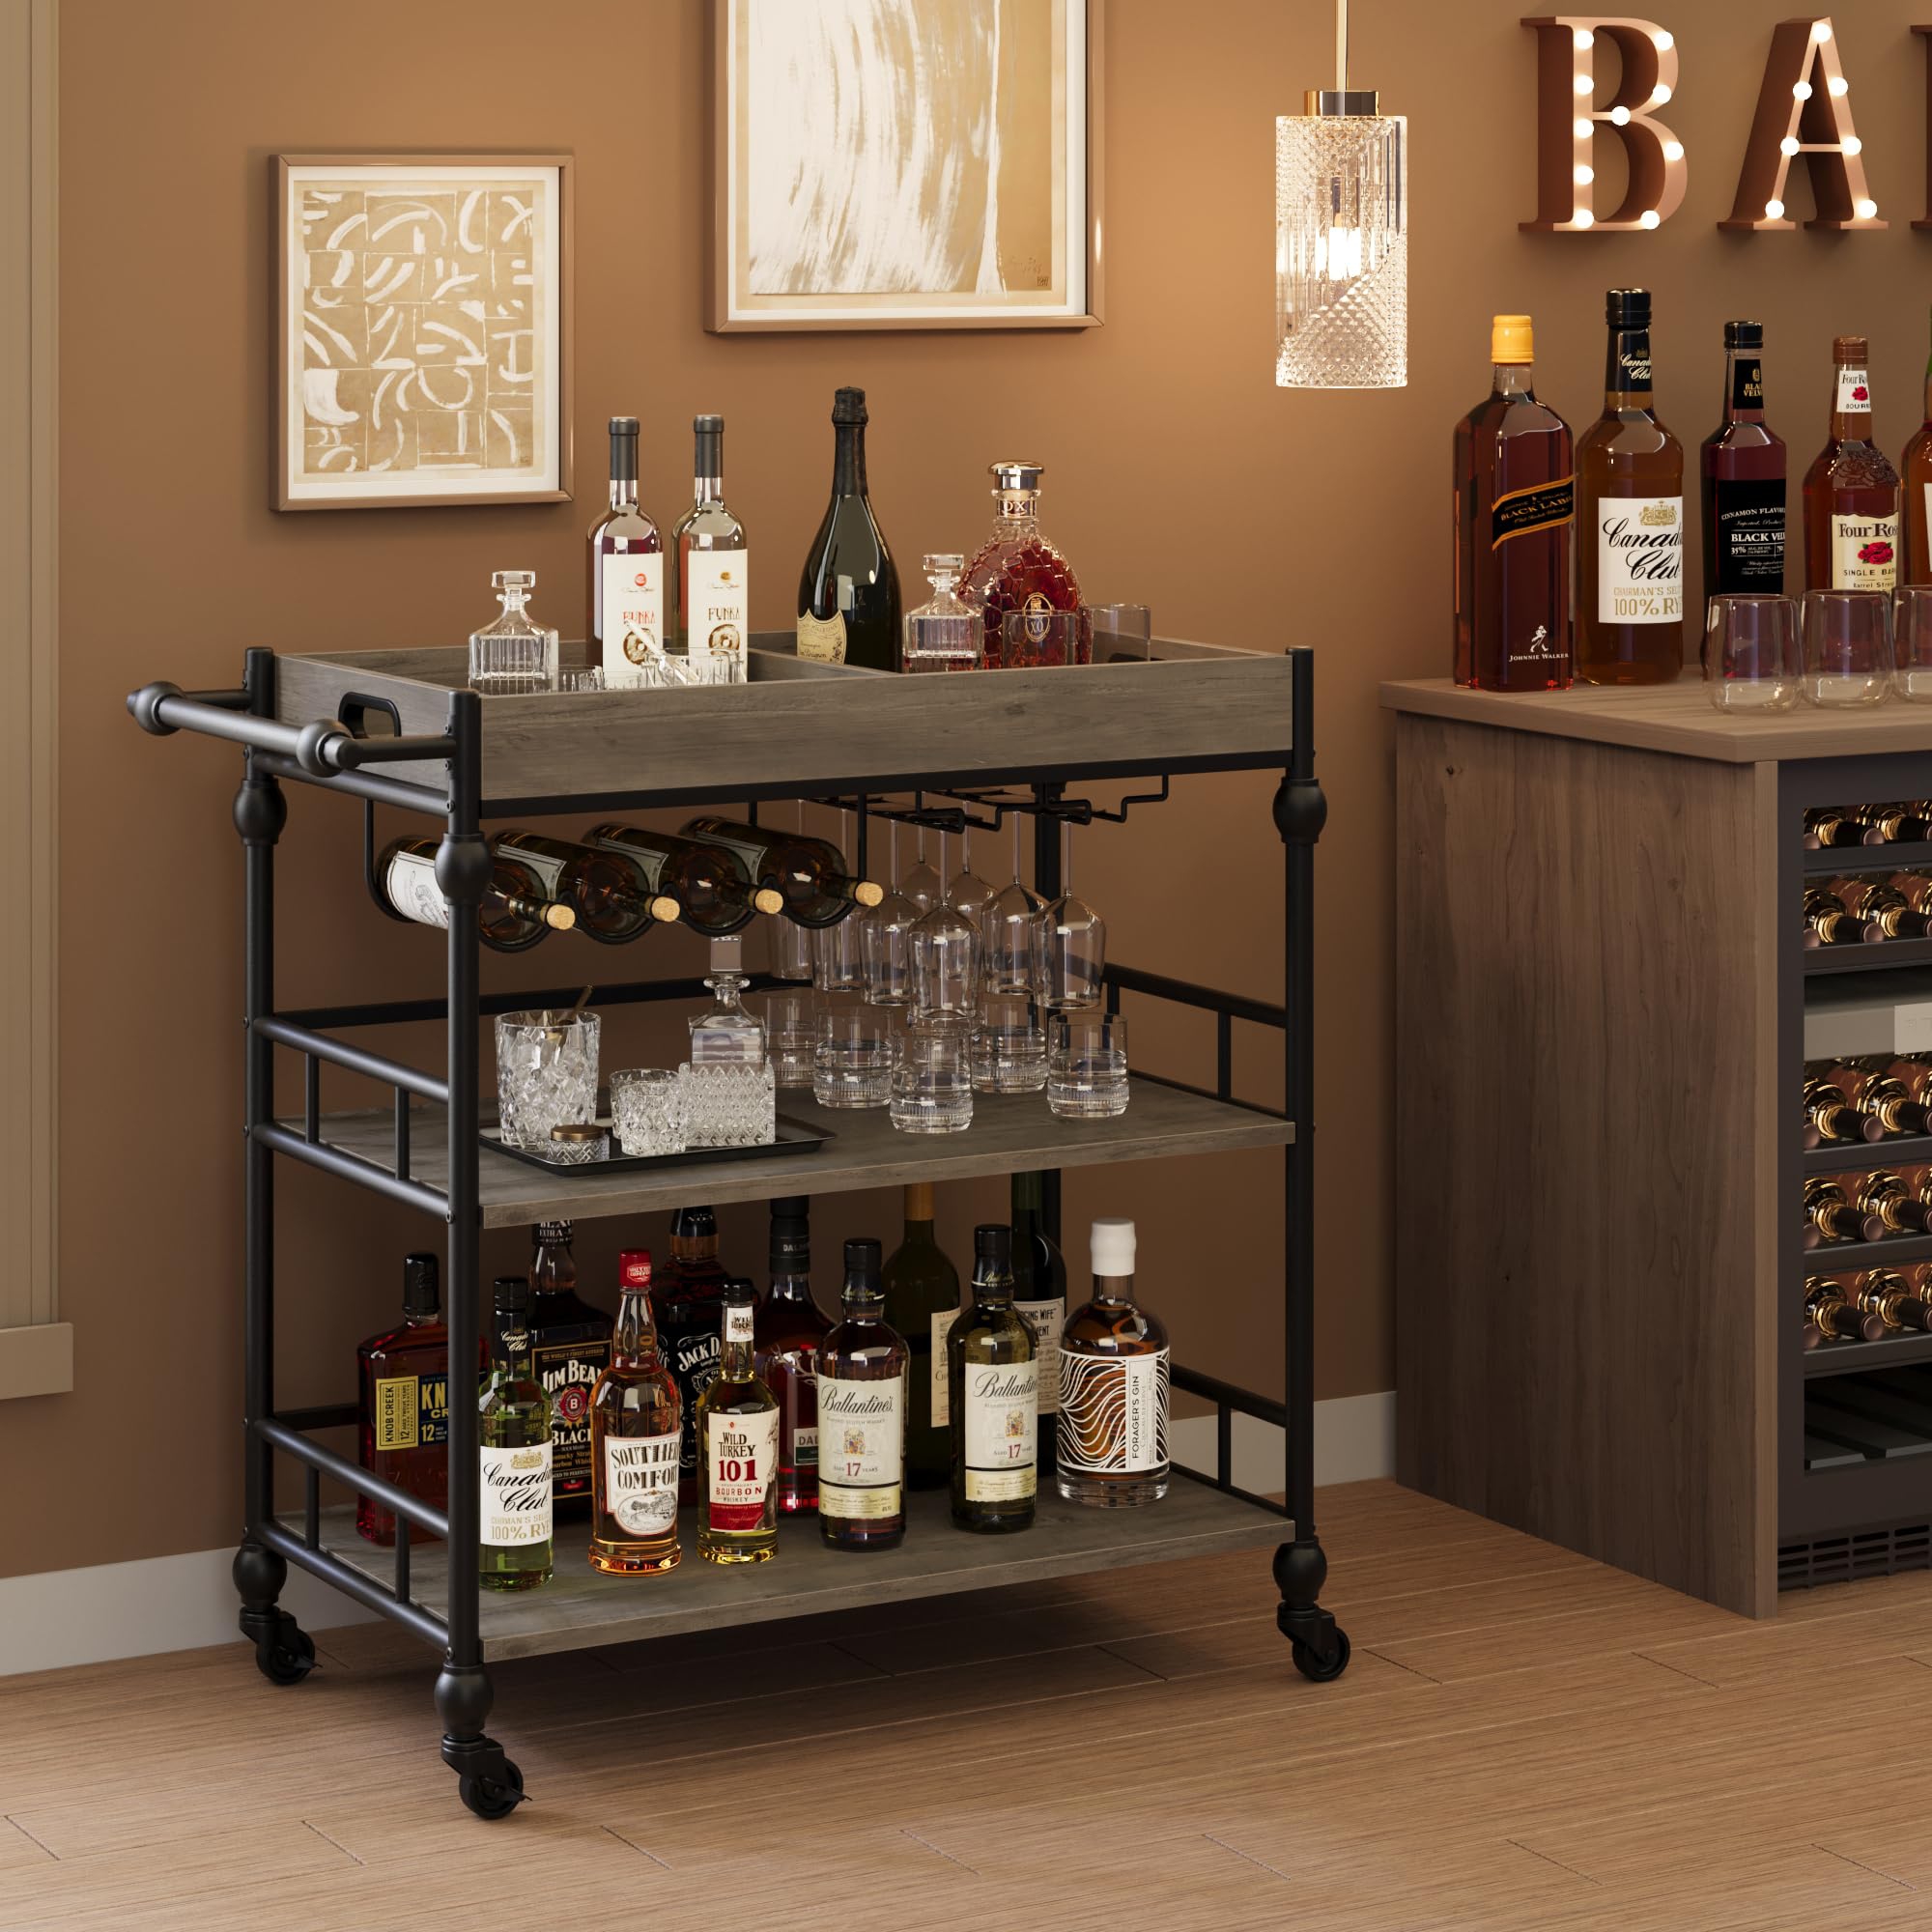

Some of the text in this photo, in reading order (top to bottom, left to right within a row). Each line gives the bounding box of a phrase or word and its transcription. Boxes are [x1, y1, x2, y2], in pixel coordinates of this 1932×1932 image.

[1519, 15, 1932, 232] BA
[1620, 354, 1652, 367] Canad
[1841, 373, 1858, 384] Four
[1500, 506, 1538, 522] BLACK
[1721, 509, 1758, 521] CINNAMON
[1602, 517, 1683, 548] Canad
[1731, 532, 1770, 542] BLACK
[1838, 523, 1898, 538] Four Ros
[1731, 546, 1747, 555] 35%
[1613, 586, 1664, 596] CHAIRMAN'S
[708, 607, 741, 621] FUNKA
[1614, 598, 1660, 616] 100%
[622, 611, 656, 625] FUNKA
[1508, 654, 1540, 663] JOHNNIE
[677, 1343, 710, 1372] JACK
[542, 1367, 566, 1395] JIM
[421, 1382, 447, 1410] KN
[570, 1398, 579, 1409] B
[820, 1384, 894, 1414] Ballantine's
[385, 1385, 394, 1442] KNOB CREEK
[1131, 1376, 1140, 1459] FORAGER'S GIN
[400, 1430, 410, 1440] 12
[421, 1424, 435, 1442] 12
[723, 1432, 748, 1445] WILD
[718, 1441, 757, 1459] TURKEY
[1008, 1443, 1021, 1459] 17
[718, 1459, 758, 1482] 101
[846, 1462, 862, 1477] 17
[716, 1486, 763, 1497] BOURBON
[491, 1525, 526, 1540] 100%
